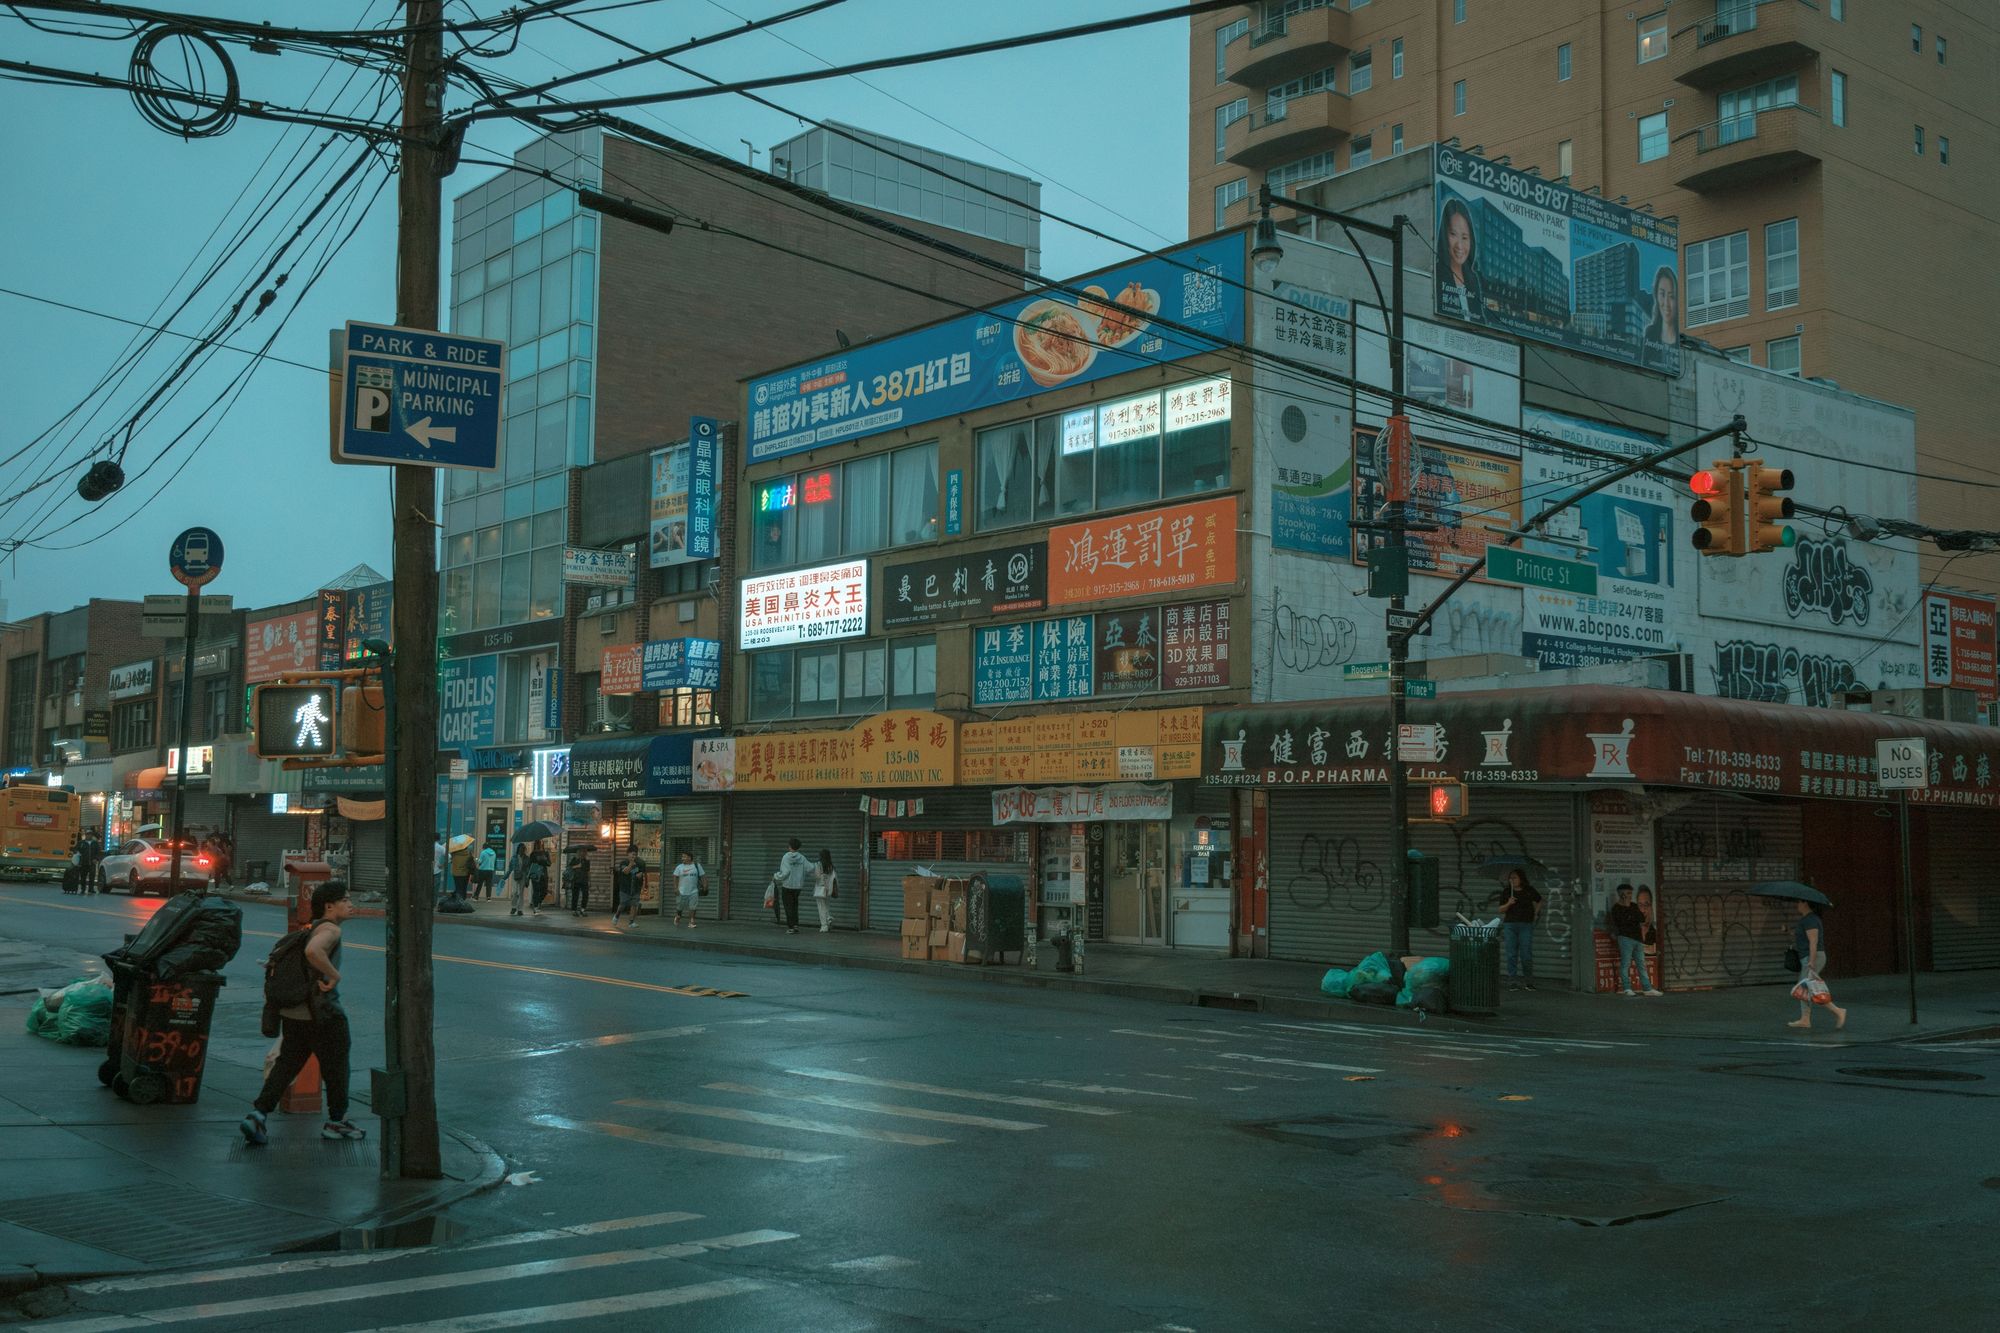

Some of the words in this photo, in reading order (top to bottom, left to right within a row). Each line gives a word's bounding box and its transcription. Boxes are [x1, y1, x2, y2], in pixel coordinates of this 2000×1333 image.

[1468, 161, 1569, 212] 212-960-8787
[1503, 200, 1544, 222] NORTHERN
[1546, 214, 1566, 229] PARC
[1631, 212, 1642, 224] WE
[1642, 218, 1655, 228] ARE
[1276, 307, 1347, 338] 日本大金冷氣
[362, 334, 413, 355] PARK
[424, 343, 436, 358] &
[447, 345, 488, 364] RIDE
[1275, 325, 1346, 356] 世界冷氣專家
[403, 370, 492, 397] MUNICIPAL
[356, 387, 389, 431] P
[402, 392, 474, 416] PARKING
[1175, 407, 1225, 426] 917-215-2968
[1108, 423, 1155, 440] 917-518-3188
[1594, 437, 1622, 452] KIOSK
[694, 440, 712, 553] 晶美眼科眼鏡
[1064, 515, 1198, 575] 鴻運罰單
[1279, 527, 1343, 545] 347-662-6666
[898, 559, 998, 602] 曼巴刺青
[1516, 559, 1553, 582] Prince
[1559, 566, 1570, 584] St
[1093, 580, 1140, 596] 917-215-2968
[1148, 573, 1195, 589] 718-618-5018
[1613, 585, 1643, 596] Self-Order
[1643, 590, 1664, 600] System
[324, 592, 341, 603] Spa
[745, 584, 862, 618] 美国鼻炎大王
[745, 618, 762, 627] USA
[767, 611, 811, 624] RHINITIS
[816, 608, 840, 618] KING
[845, 604, 863, 614] INC
[1166, 603, 1230, 626] 商業店面
[1391, 616, 1403, 626] ONE
[798, 625, 805, 638] T:
[1042, 617, 1087, 649] 保險
[1104, 613, 1157, 650] 亞泰
[1539, 614, 1663, 643] www.abcpos.com
[484, 632, 513, 647] 135-16
[983, 624, 1025, 654] 四季
[1930, 603, 1948, 677] 亞泰
[1039, 649, 1061, 665] 汽車
[1067, 646, 1089, 662] 房屋
[1565, 642, 1586, 652] College
[1587, 645, 1600, 653] Point
[1601, 647, 1616, 656] Blvd,
[983, 656, 988, 666] &
[990, 656, 995, 665] Z
[996, 654, 1030, 665] INSURANCE
[1351, 664, 1383, 675] Roosevelt
[1039, 665, 1060, 682] 商業
[1175, 674, 1220, 686] 929-317-1103
[444, 675, 494, 709] FIDELIS
[978, 677, 1030, 690] 929.200.7152
[1039, 681, 1060, 698] 人壽
[1067, 679, 1089, 696] 其他
[1407, 682, 1428, 697] Prince
[443, 711, 479, 742] CARE
[860, 716, 948, 752] 華豐商場
[716, 742, 729, 751] SPA
[1491, 738, 1503, 756] Rx
[1602, 743, 1621, 765] Rx
[1891, 747, 1912, 761] NO
[473, 750, 516, 768] WellCare
[886, 750, 920, 764] 135-08
[1684, 746, 1705, 764] Tel:
[1707, 749, 1781, 772] 718-359-6333
[876, 770, 886, 782] AE
[889, 769, 924, 782] COMPANY
[928, 769, 944, 782] INC.
[1205, 775, 1233, 784] 135-02
[1235, 774, 1261, 784] #1234
[1464, 770, 1538, 781] 718-359-6333
[1680, 767, 1705, 784] Fax:
[1707, 769, 1780, 791] 718-359-5339
[1881, 767, 1923, 780] BUSES
[578, 780, 605, 790] Precision
[608, 778, 620, 792] Eye
[622, 778, 638, 788] Care
